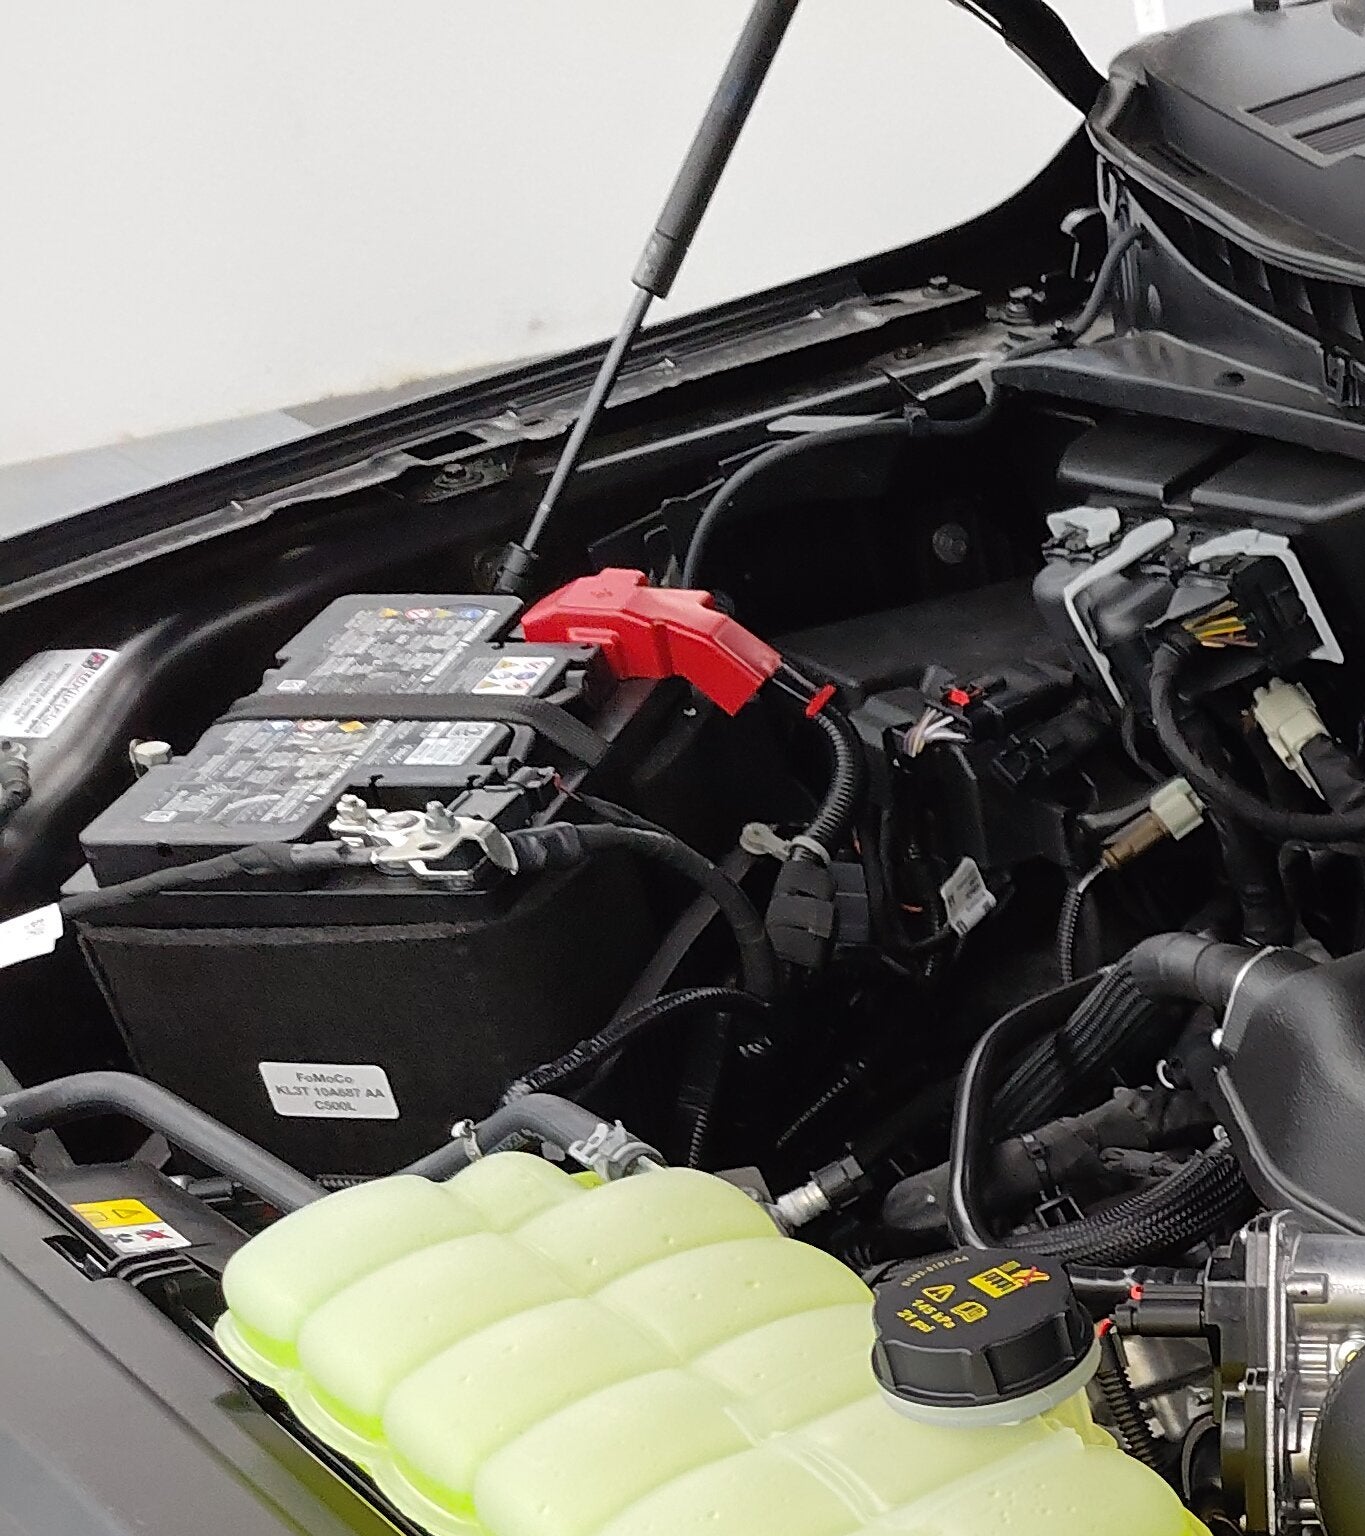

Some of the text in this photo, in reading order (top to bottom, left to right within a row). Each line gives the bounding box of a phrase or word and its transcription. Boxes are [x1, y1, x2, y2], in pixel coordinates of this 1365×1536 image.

[296, 1072, 354, 1084] FoMoCo
[366, 1089, 385, 1098] AA
[896, 1309, 936, 1333] 21 psi
